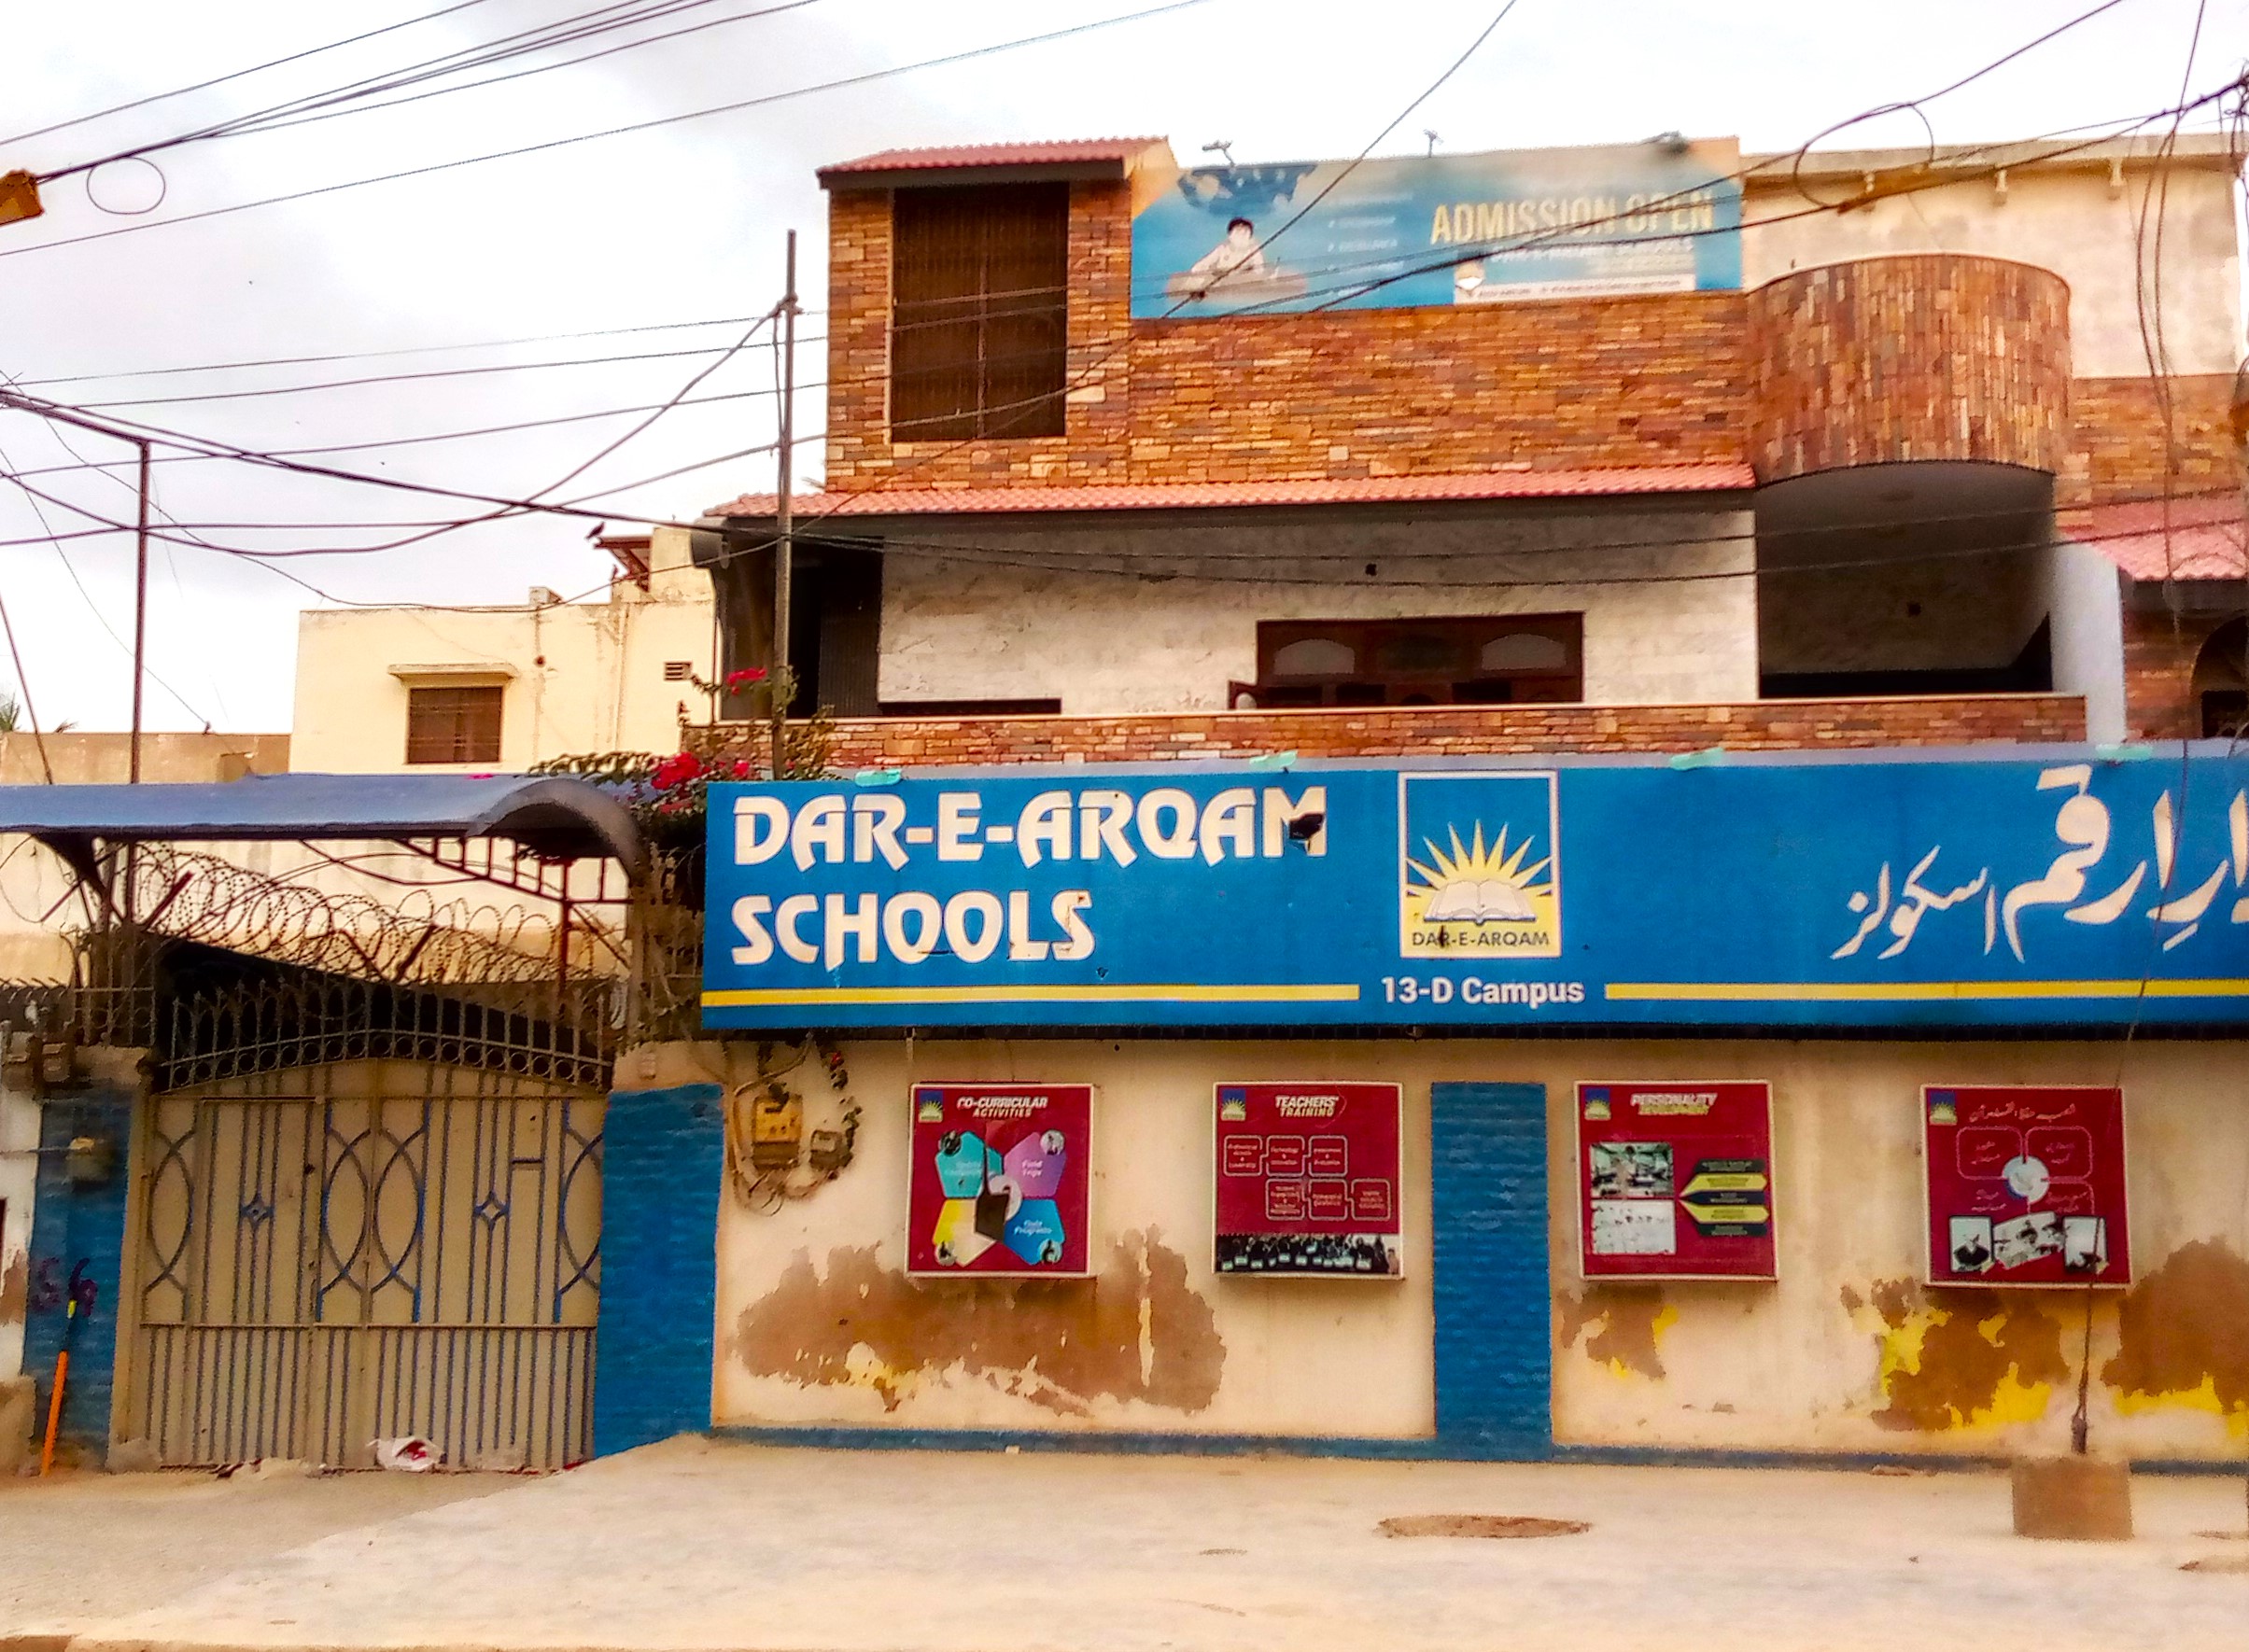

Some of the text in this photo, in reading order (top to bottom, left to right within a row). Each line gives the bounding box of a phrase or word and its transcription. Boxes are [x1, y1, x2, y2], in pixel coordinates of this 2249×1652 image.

[1430, 189, 1714, 245] ADMISSION OPEN
[733, 785, 1328, 872] DAR-E-ARQAM
[732, 889, 1096, 968] SCHOOLS
[1412, 931, 1550, 946] DAR-E-ARQAM
[1381, 976, 1586, 1009] 13-D Campus
[972, 1107, 1033, 1118] ACTIVITIES
[1280, 1106, 1335, 1117] TRAINING
